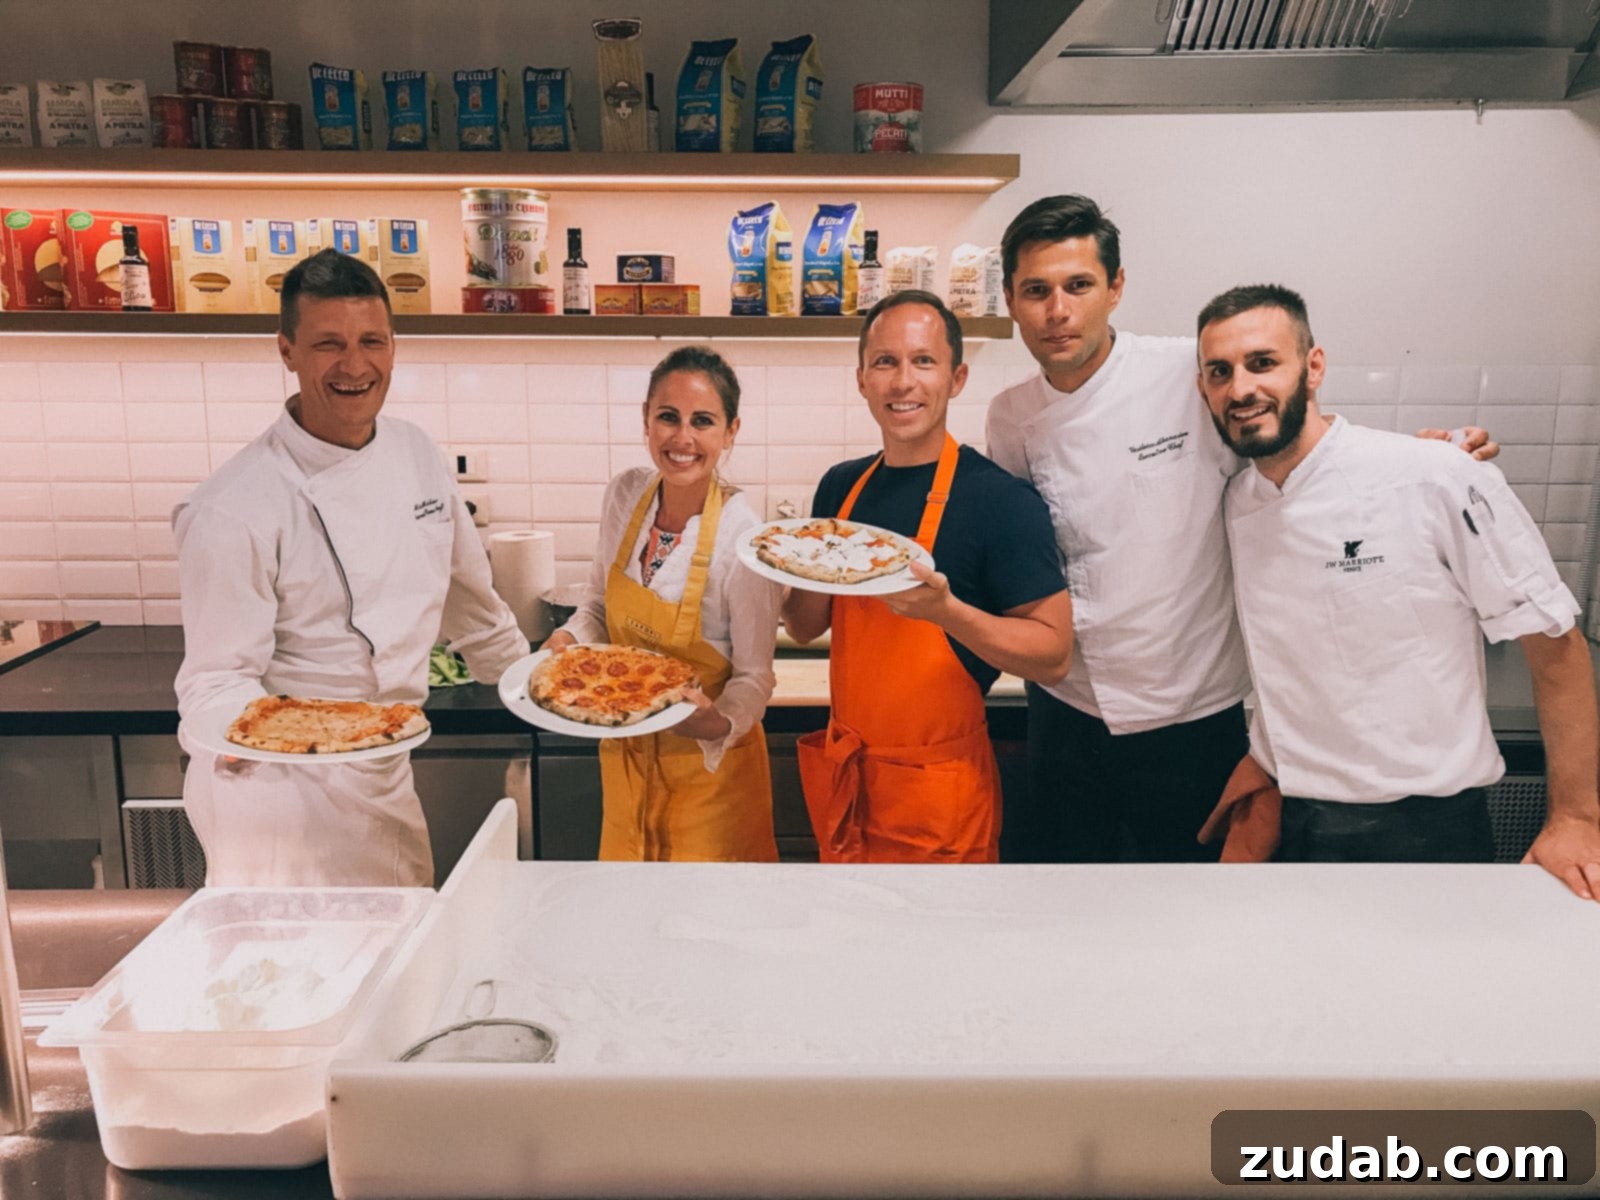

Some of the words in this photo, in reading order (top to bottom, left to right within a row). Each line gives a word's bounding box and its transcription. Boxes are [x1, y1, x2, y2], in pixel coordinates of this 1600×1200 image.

[875, 88, 908, 99] MUTTI
[875, 128, 907, 138] PELATI
[1325, 560, 1337, 569] JW
[1338, 555, 1385, 568] MARRIOTT
